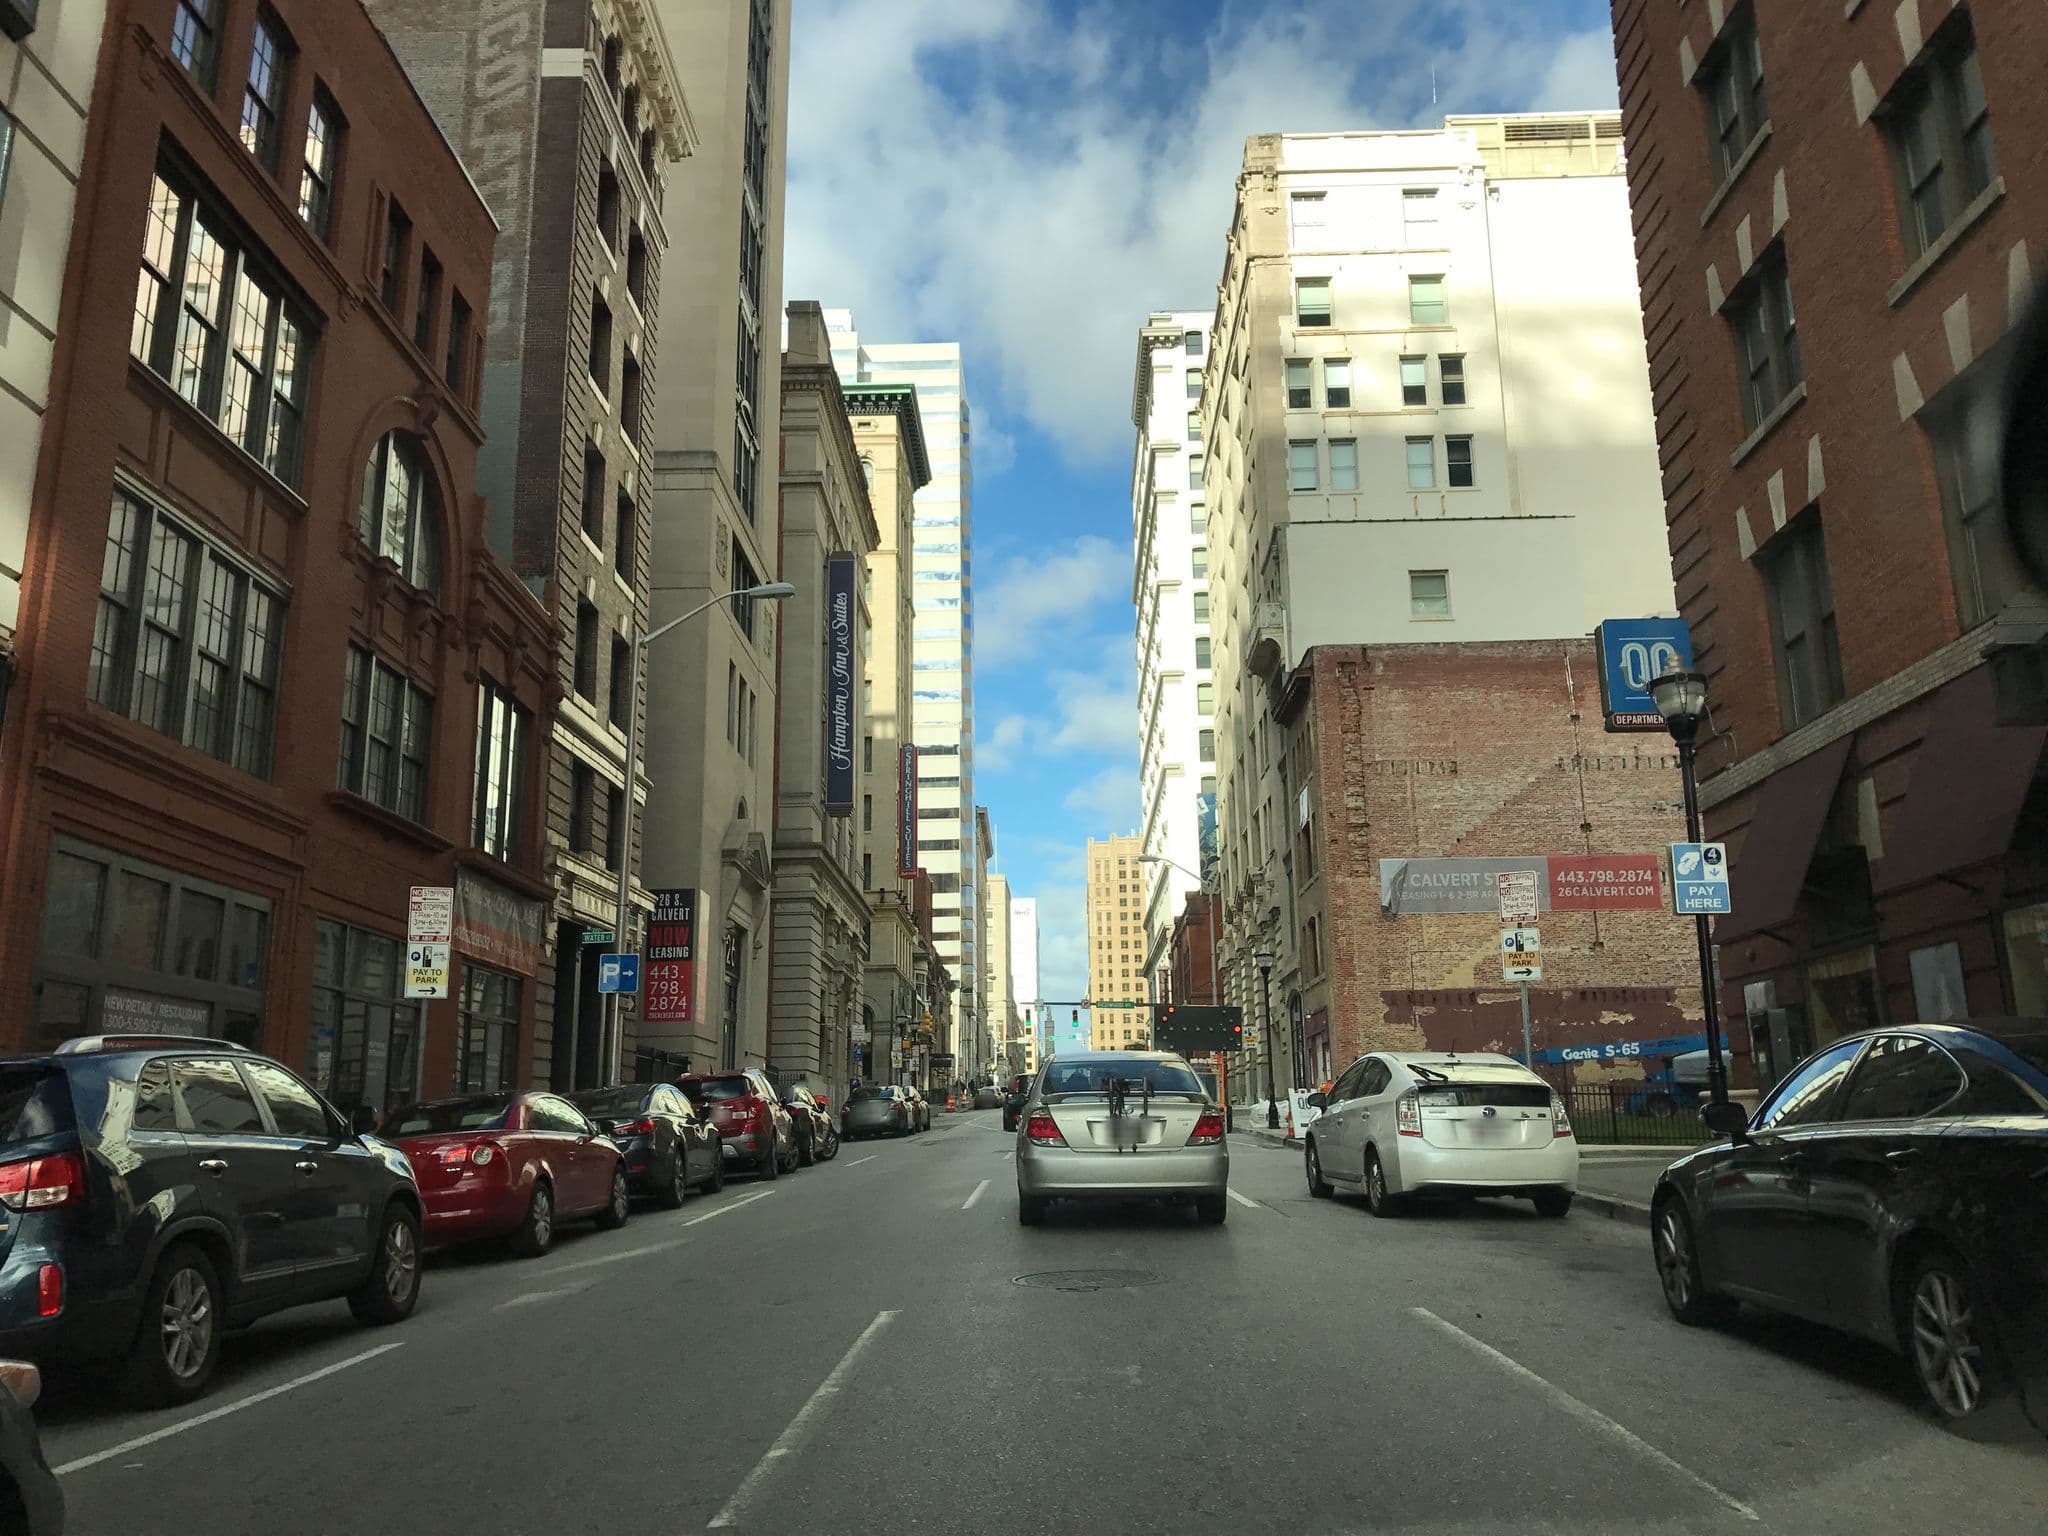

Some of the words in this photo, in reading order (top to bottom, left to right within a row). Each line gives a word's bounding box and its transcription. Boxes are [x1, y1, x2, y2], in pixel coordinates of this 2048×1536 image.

[832, 592, 850, 635] Suites
[832, 645, 850, 686] Inn
[1616, 714, 1664, 725] DEPARTMEN
[830, 687, 852, 770] Hampton
[903, 752, 911, 822] SPRINGHILL
[903, 825, 911, 869] SUITES
[1708, 848, 1718, 859] 4
[1410, 872, 1480, 887] CALVERT
[1557, 870, 1652, 883] 443.798.2874
[1558, 886, 1654, 897] 26CALVERT.COM
[1689, 886, 1715, 897] PAY
[659, 894, 670, 907] 26
[674, 893, 683, 906] S.
[1685, 897, 1722, 909] HERE
[651, 908, 690, 921] CALVERT
[584, 934, 605, 942] WATER
[650, 927, 689, 946] NOW
[650, 947, 689, 959] LEASING
[1511, 959, 1532, 967] PARK
[413, 968, 431, 976] PAY
[431, 968, 442, 976] TO
[650, 965, 684, 979] 443.
[650, 981, 684, 995] 798.
[104, 995, 125, 1010] NEW
[125, 999, 152, 1015] RETAIL
[649, 996, 688, 1011] 2874
[1562, 1048, 1599, 1060] Genie
[1605, 1042, 1640, 1057] S-65
